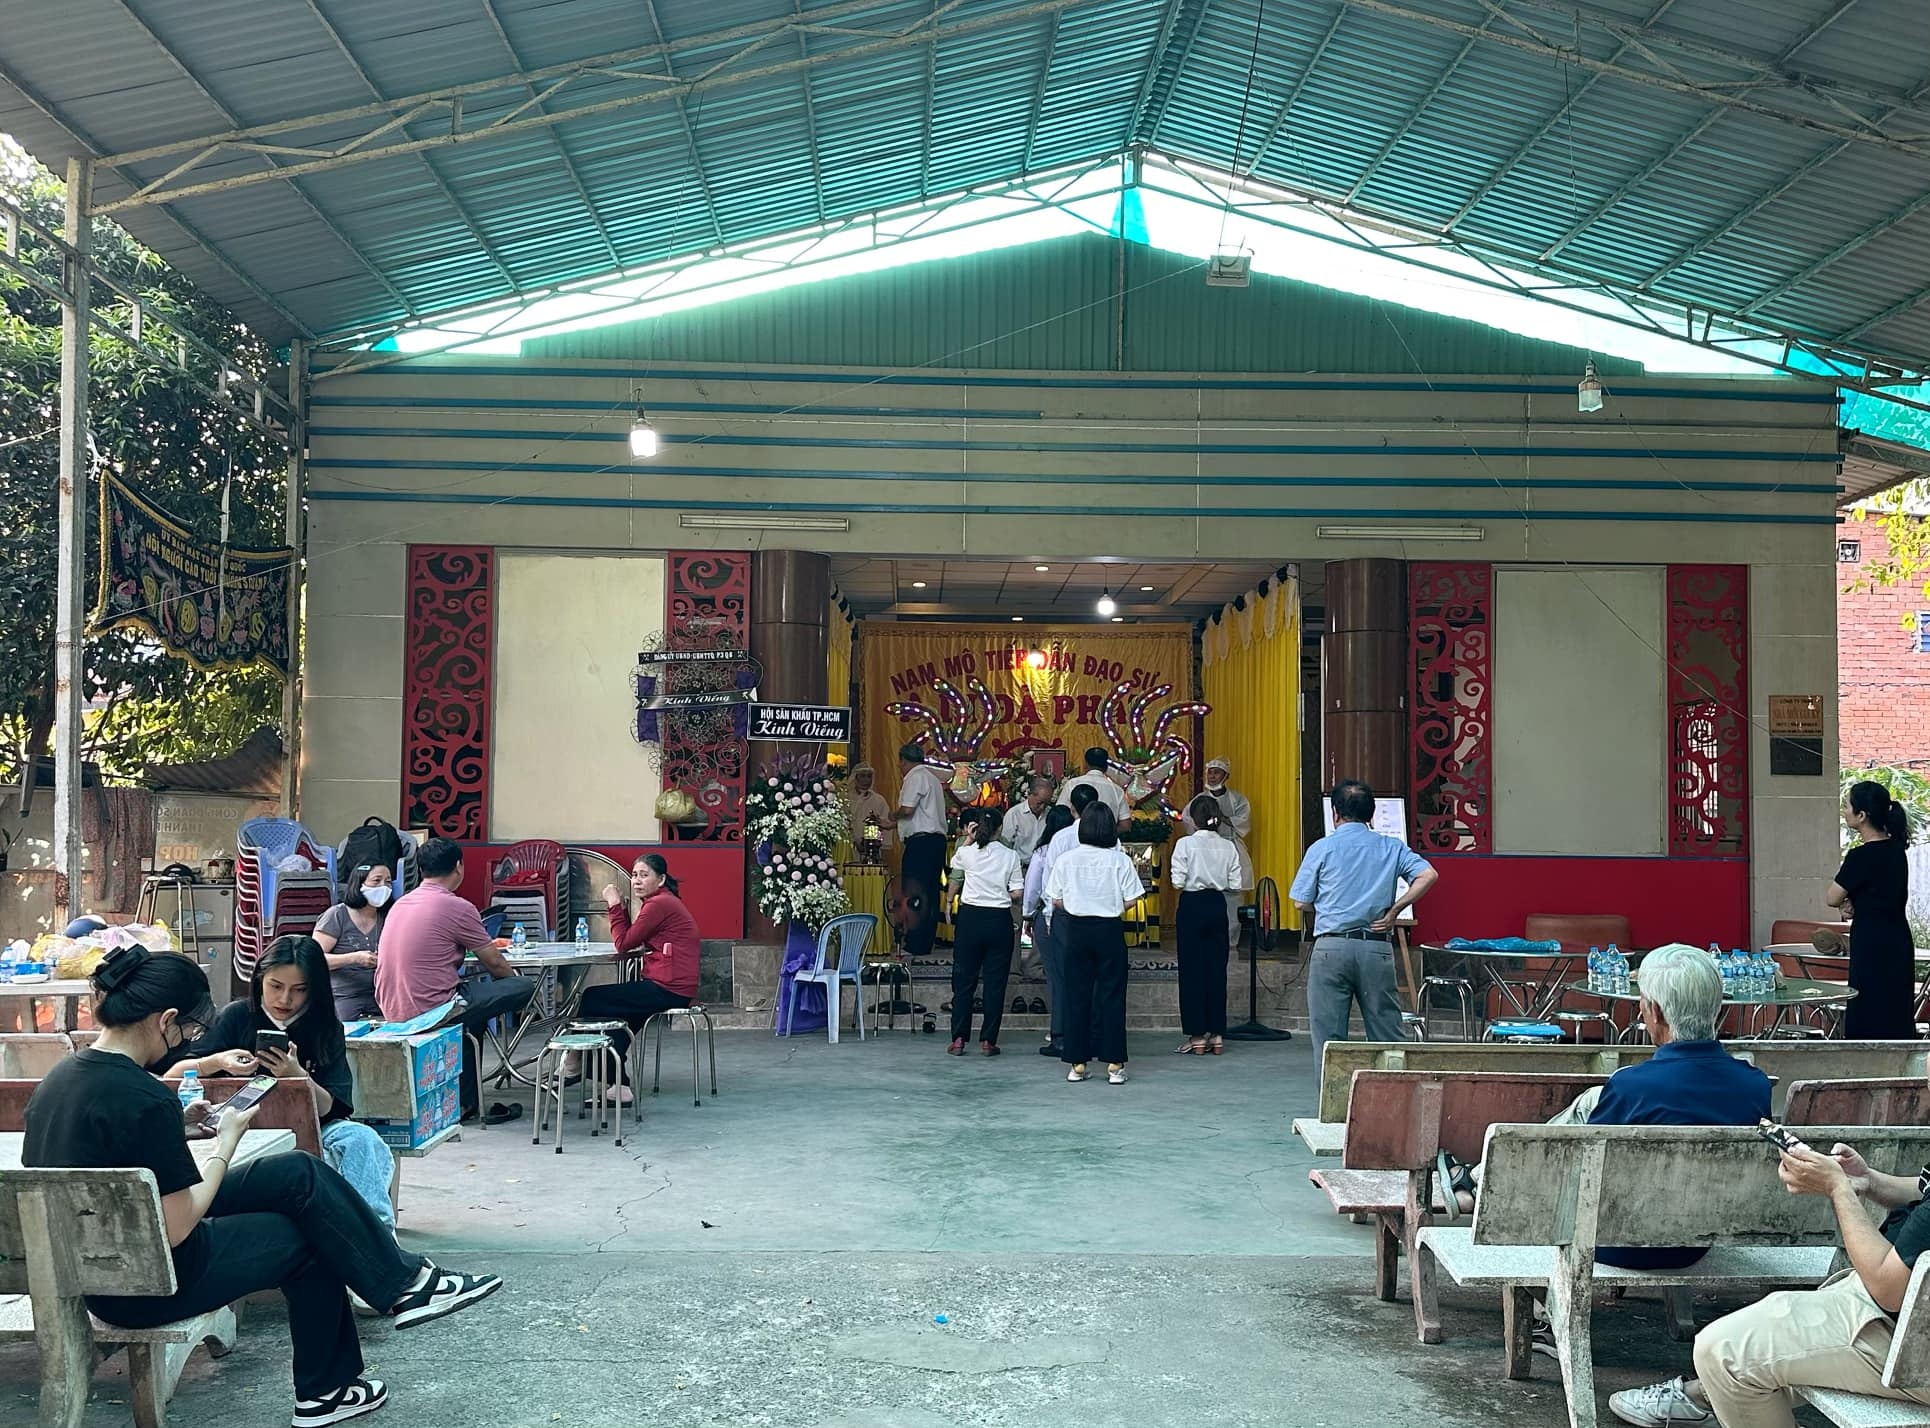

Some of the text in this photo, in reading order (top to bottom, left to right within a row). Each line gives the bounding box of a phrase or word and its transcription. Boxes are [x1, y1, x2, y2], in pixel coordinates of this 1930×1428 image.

[146, 532, 160, 555] HỘI
[161, 544, 183, 571] NGƯỜI
[184, 560, 199, 577] CAO
[890, 661, 938, 695] NAM
[943, 647, 977, 677] MÔ
[1083, 654, 1125, 684] ĐẠO
[1132, 667, 1161, 690] SƯ
[760, 707, 774, 721] HỘI
[792, 707, 811, 721] KHẤU
[812, 711, 840, 722] TP.HCM
[800, 722, 844, 740] Viếng
